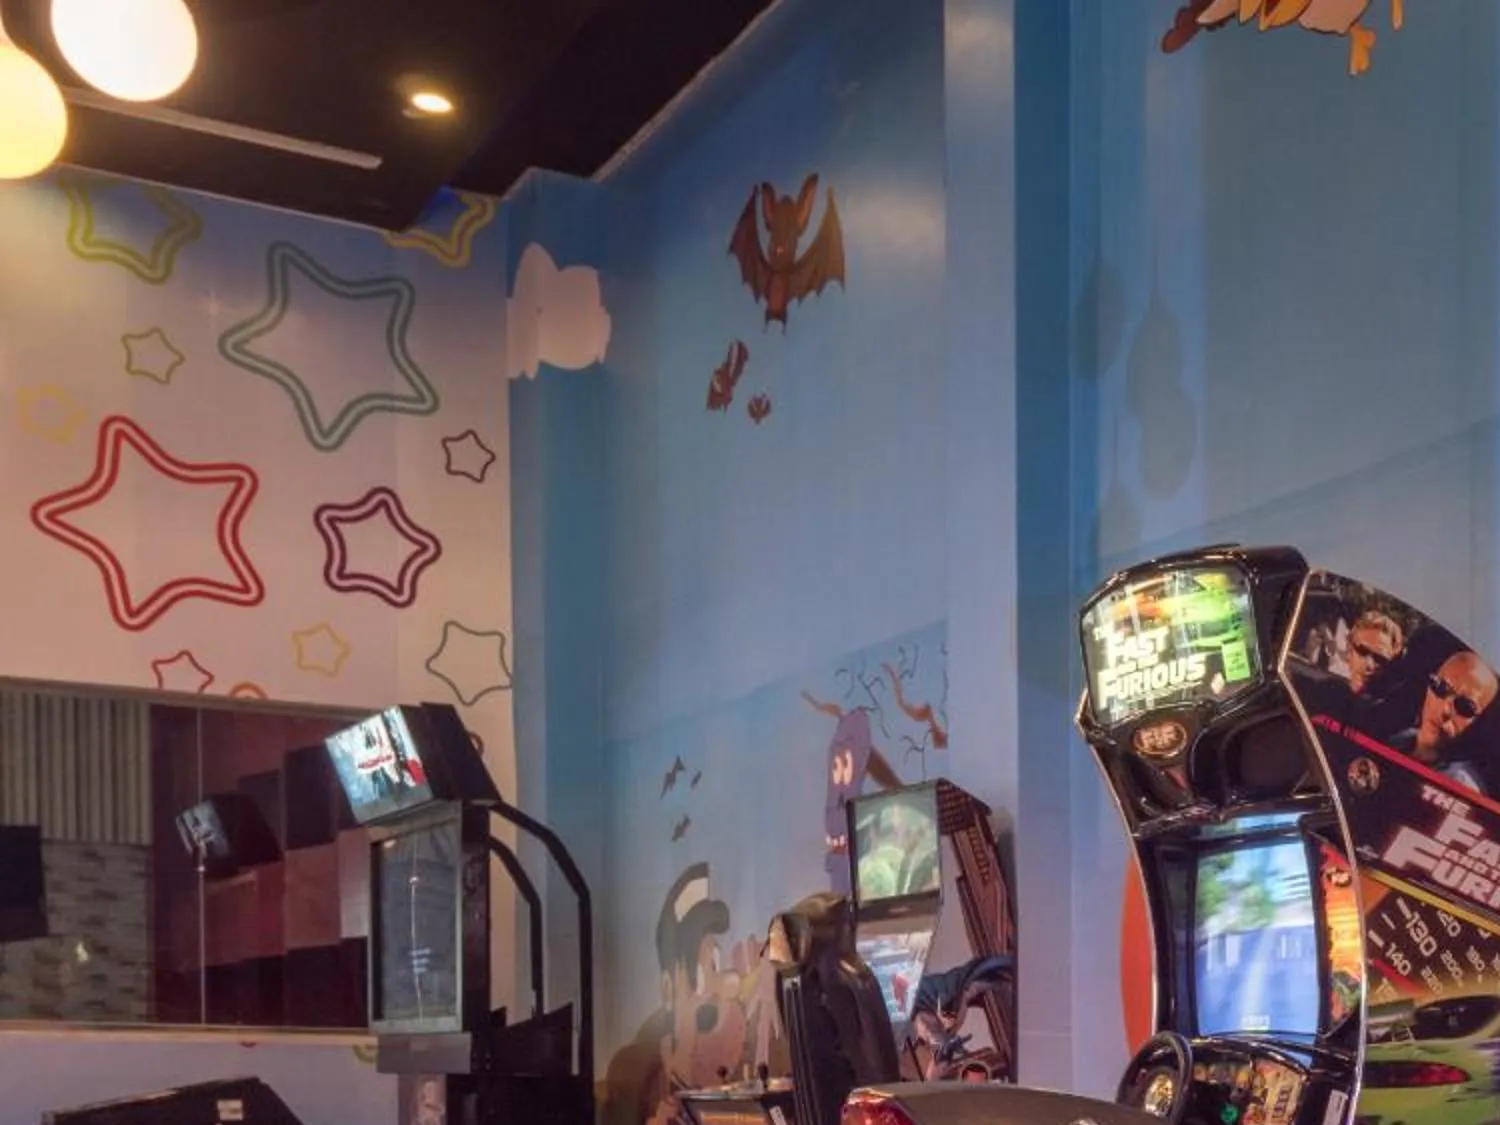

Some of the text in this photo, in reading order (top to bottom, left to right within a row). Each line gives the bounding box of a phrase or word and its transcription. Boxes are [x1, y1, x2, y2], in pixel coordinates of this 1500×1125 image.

[1105, 625, 1169, 671] FAST
[1097, 653, 1207, 711] FURIOUS
[1421, 785, 1471, 819] THE
[1444, 848, 1489, 876] AND
[1406, 911, 1438, 957] 130
[1385, 941, 1412, 977] 140
